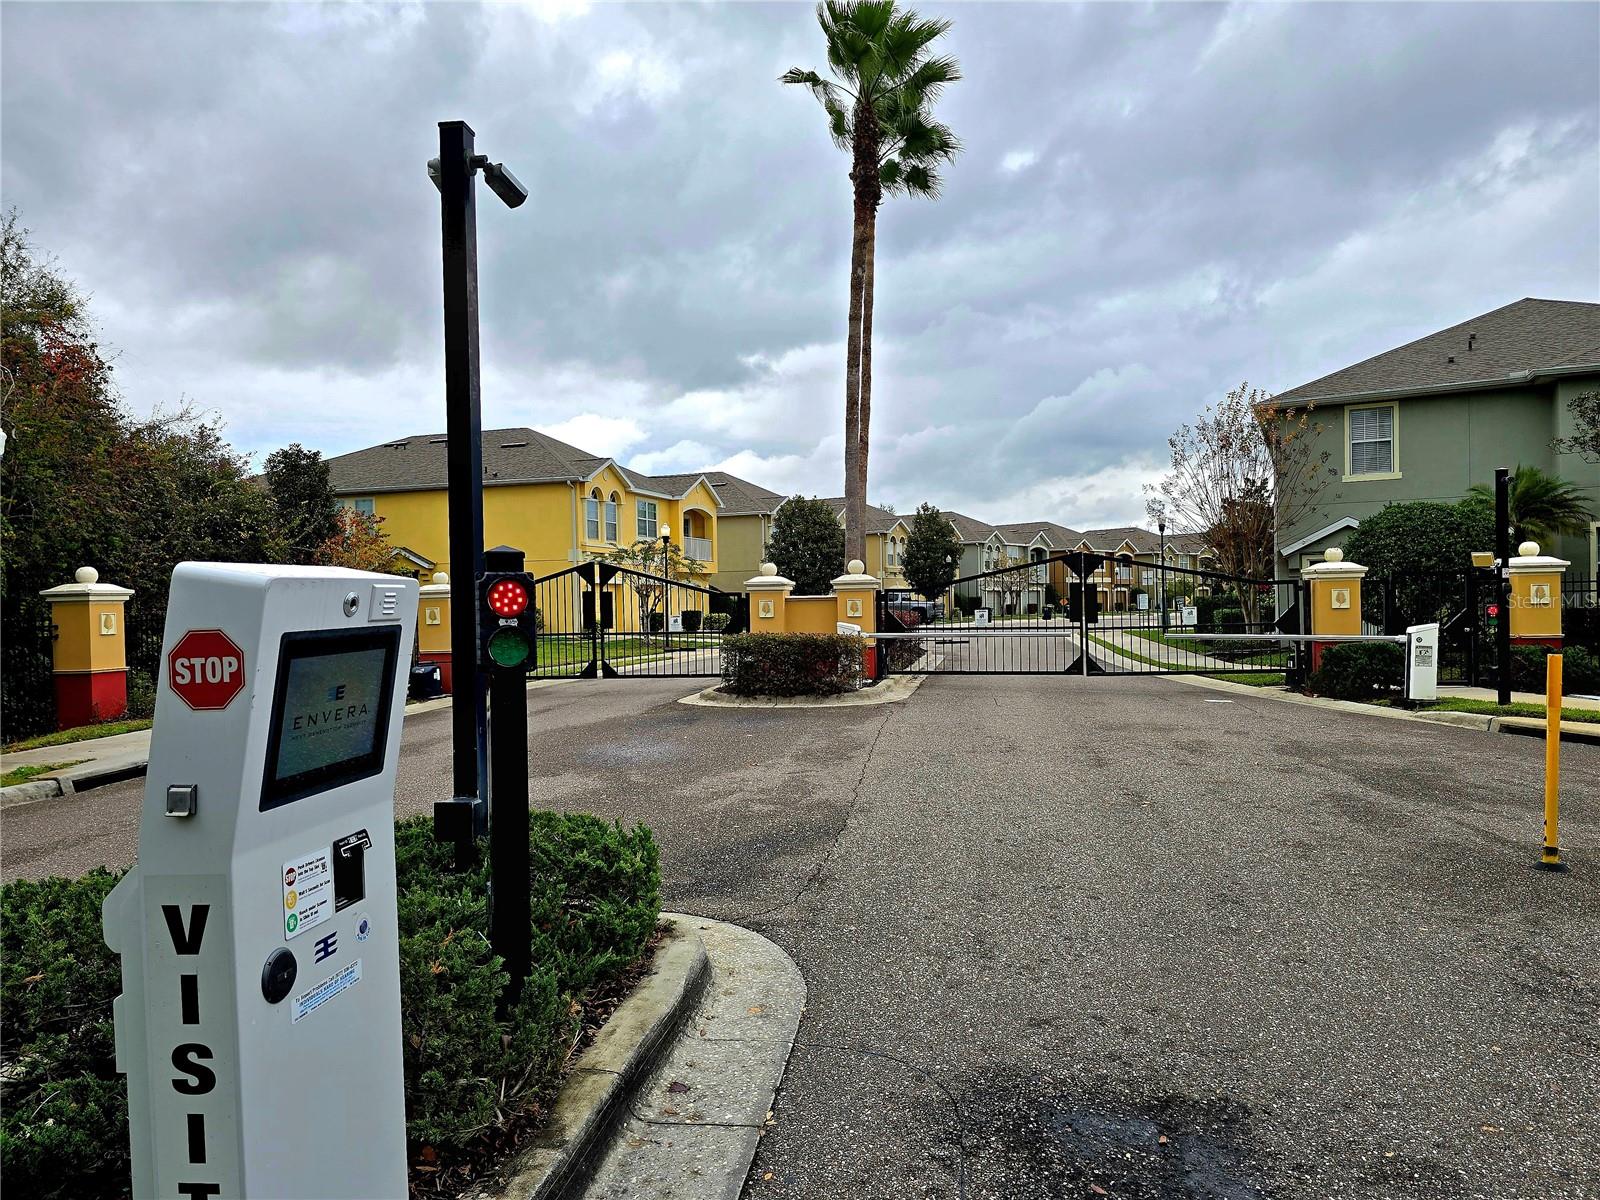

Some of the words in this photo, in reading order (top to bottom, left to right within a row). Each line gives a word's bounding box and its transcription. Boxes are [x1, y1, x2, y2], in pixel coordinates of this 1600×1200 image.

[175, 656, 238, 684] STOP
[293, 704, 367, 730] ENVERA
[285, 872, 297, 884] STOP
